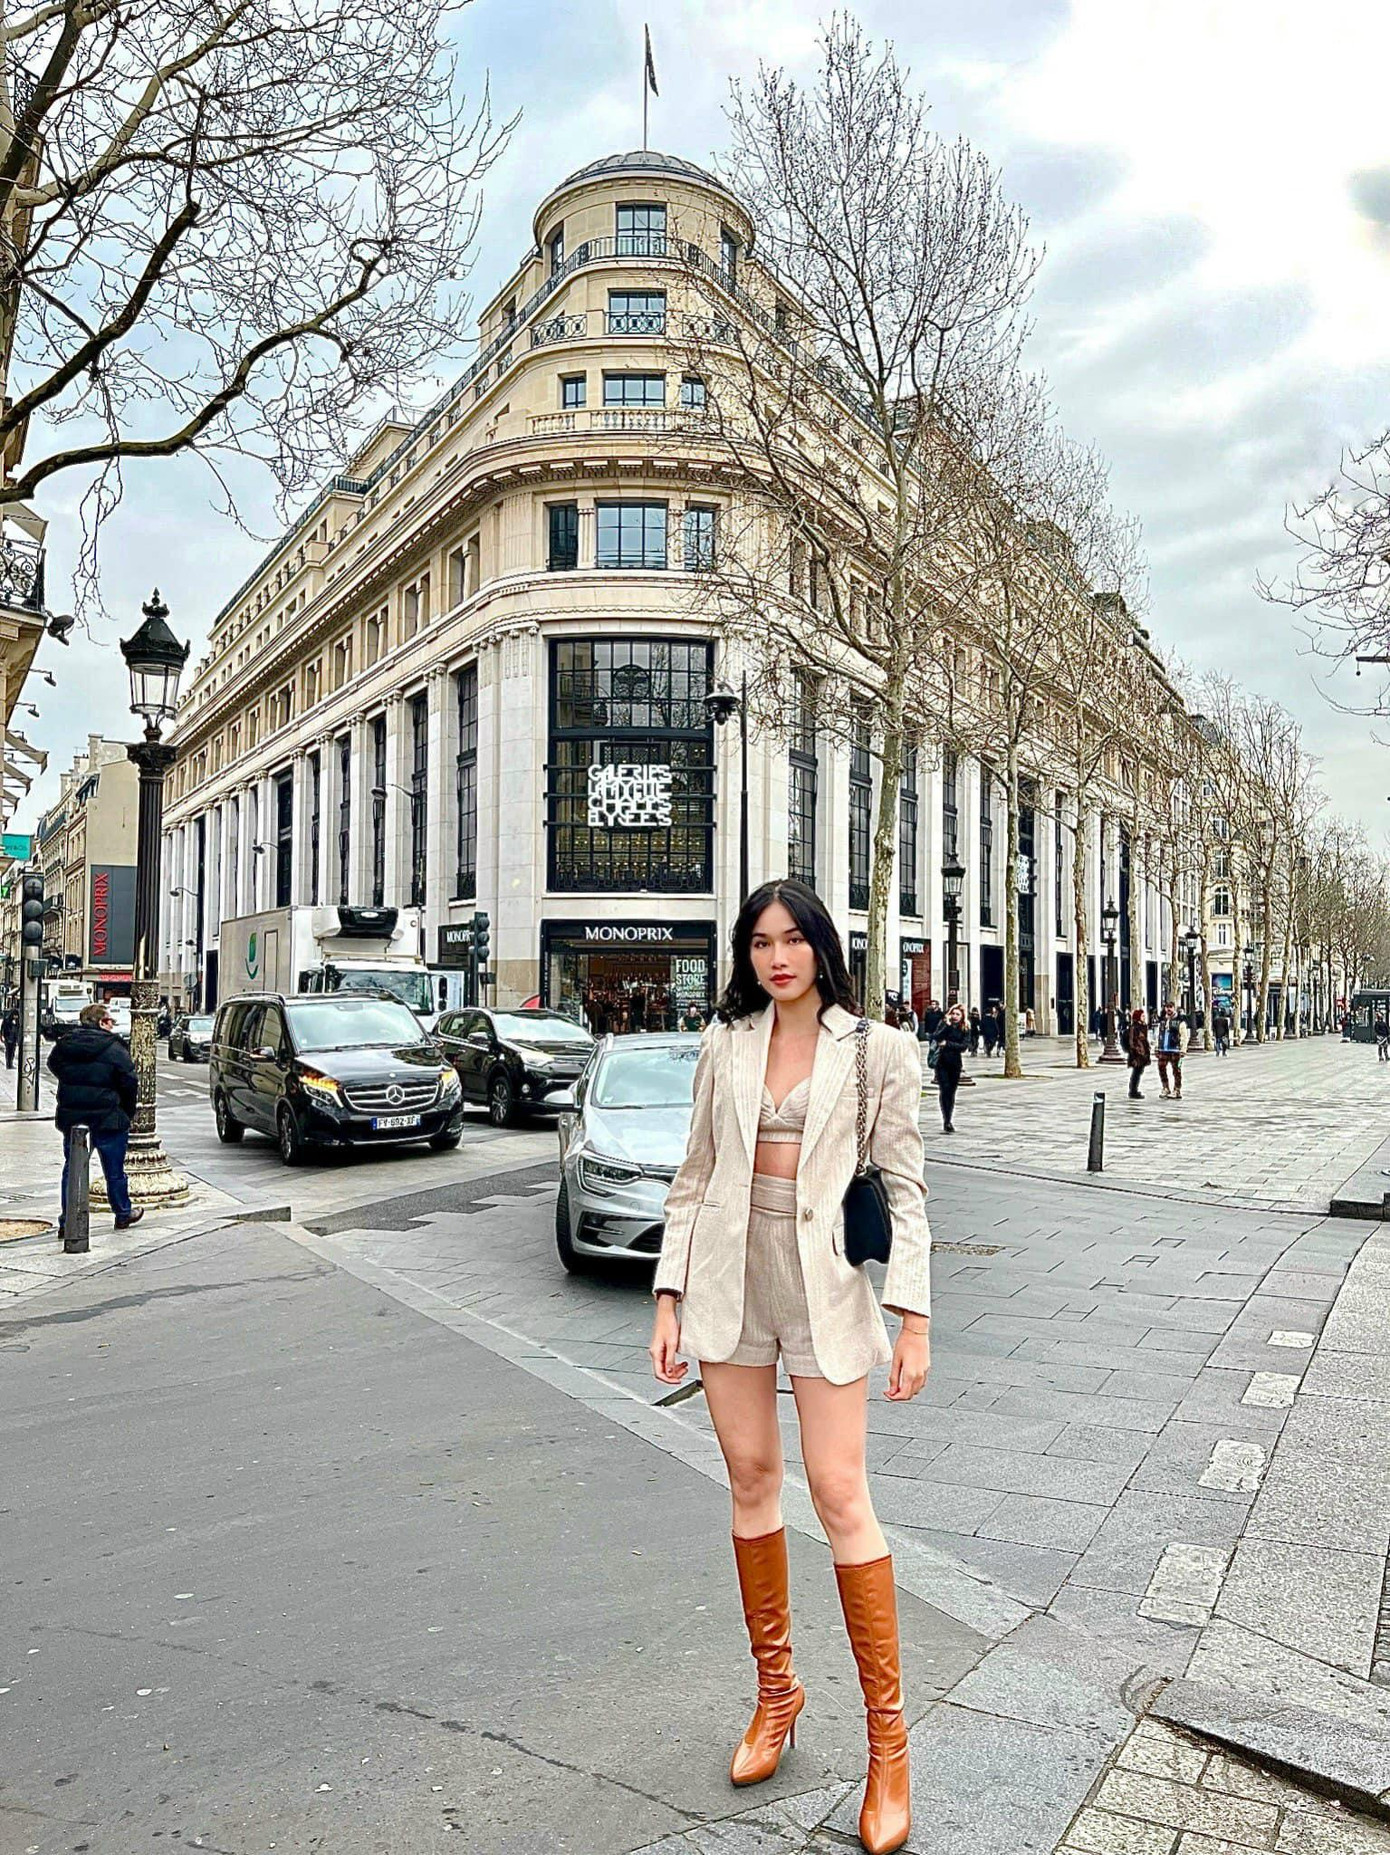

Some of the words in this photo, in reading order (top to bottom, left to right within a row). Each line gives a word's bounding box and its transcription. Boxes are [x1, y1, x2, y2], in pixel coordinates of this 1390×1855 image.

[588, 764, 672, 783] GALERIES
[93, 872, 109, 957] MONOPRIX
[585, 926, 674, 941] MONOPRIX
[675, 959, 705, 973] FOOD
[675, 973, 706, 985] STORE
